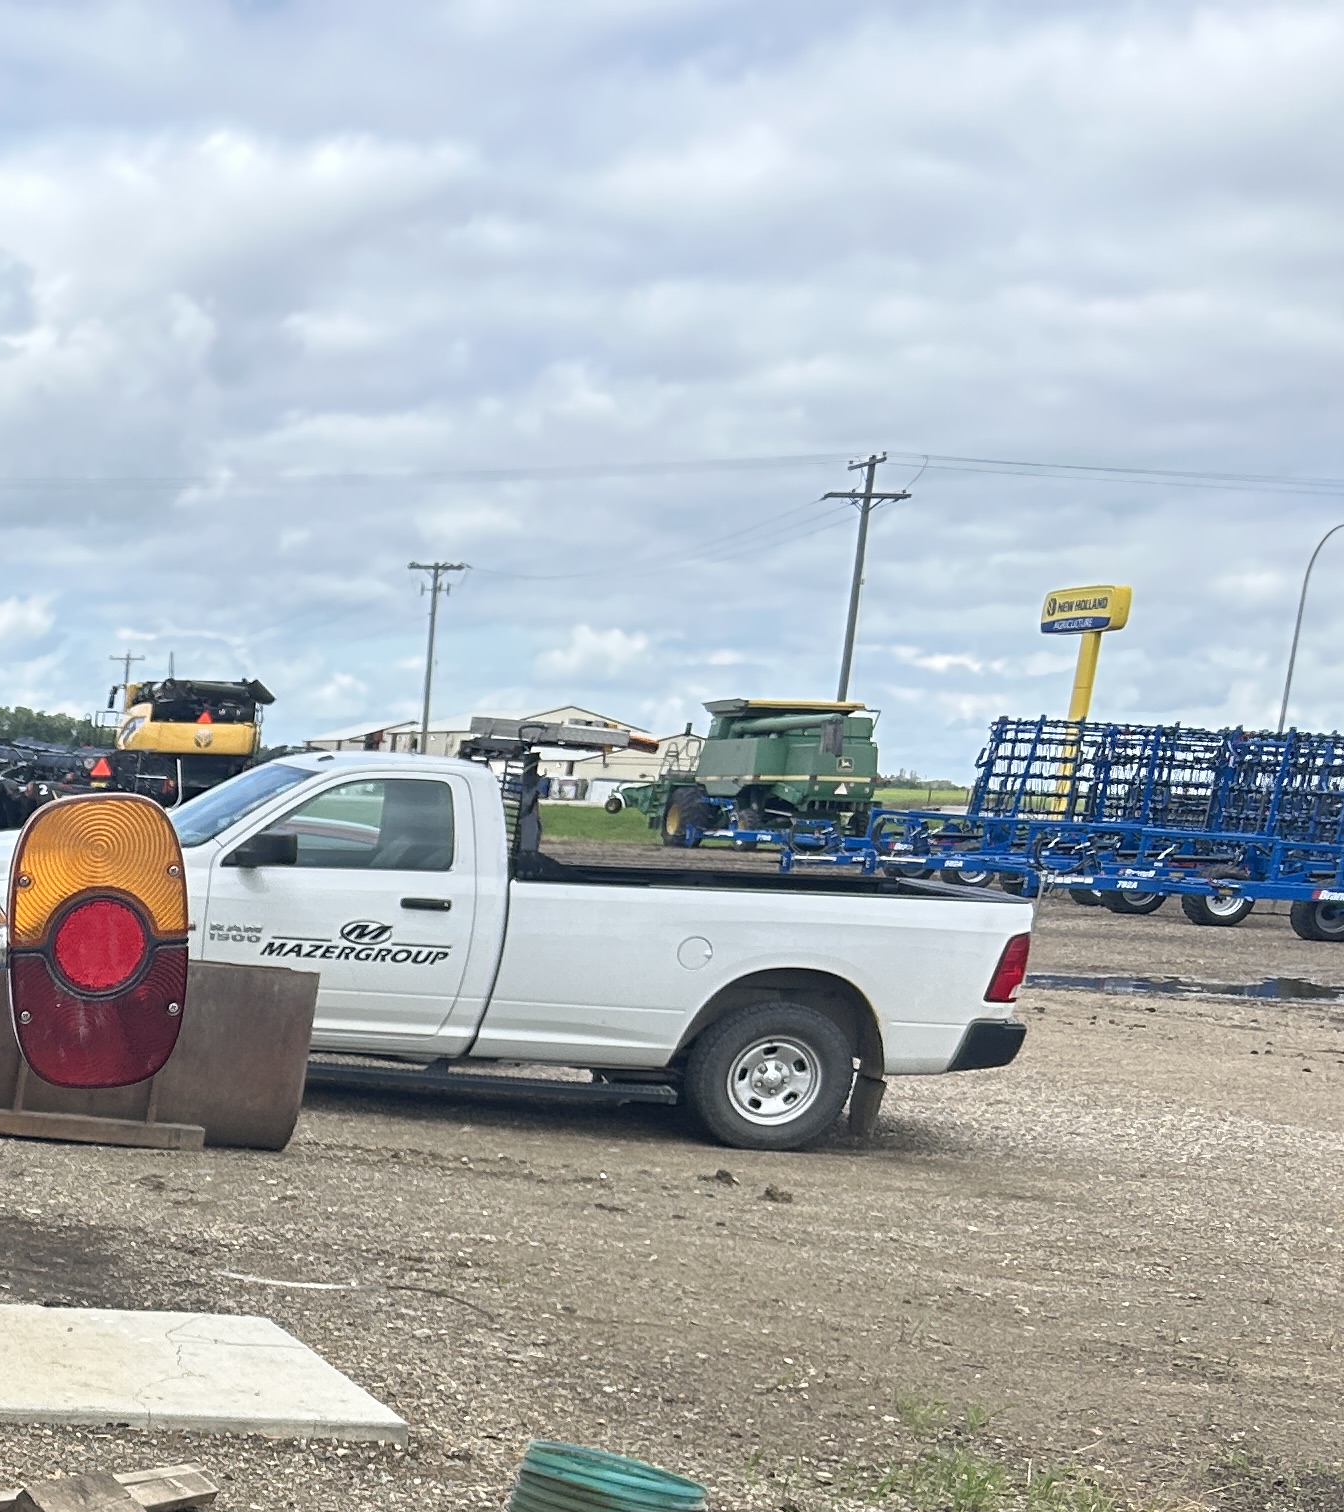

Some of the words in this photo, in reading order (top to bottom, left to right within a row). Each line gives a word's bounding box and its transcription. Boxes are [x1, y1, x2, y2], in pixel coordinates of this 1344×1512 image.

[1057, 600, 1074, 613] NEW
[1074, 597, 1109, 611] HOLLAND
[259, 941, 450, 966] MAZERGROUP
